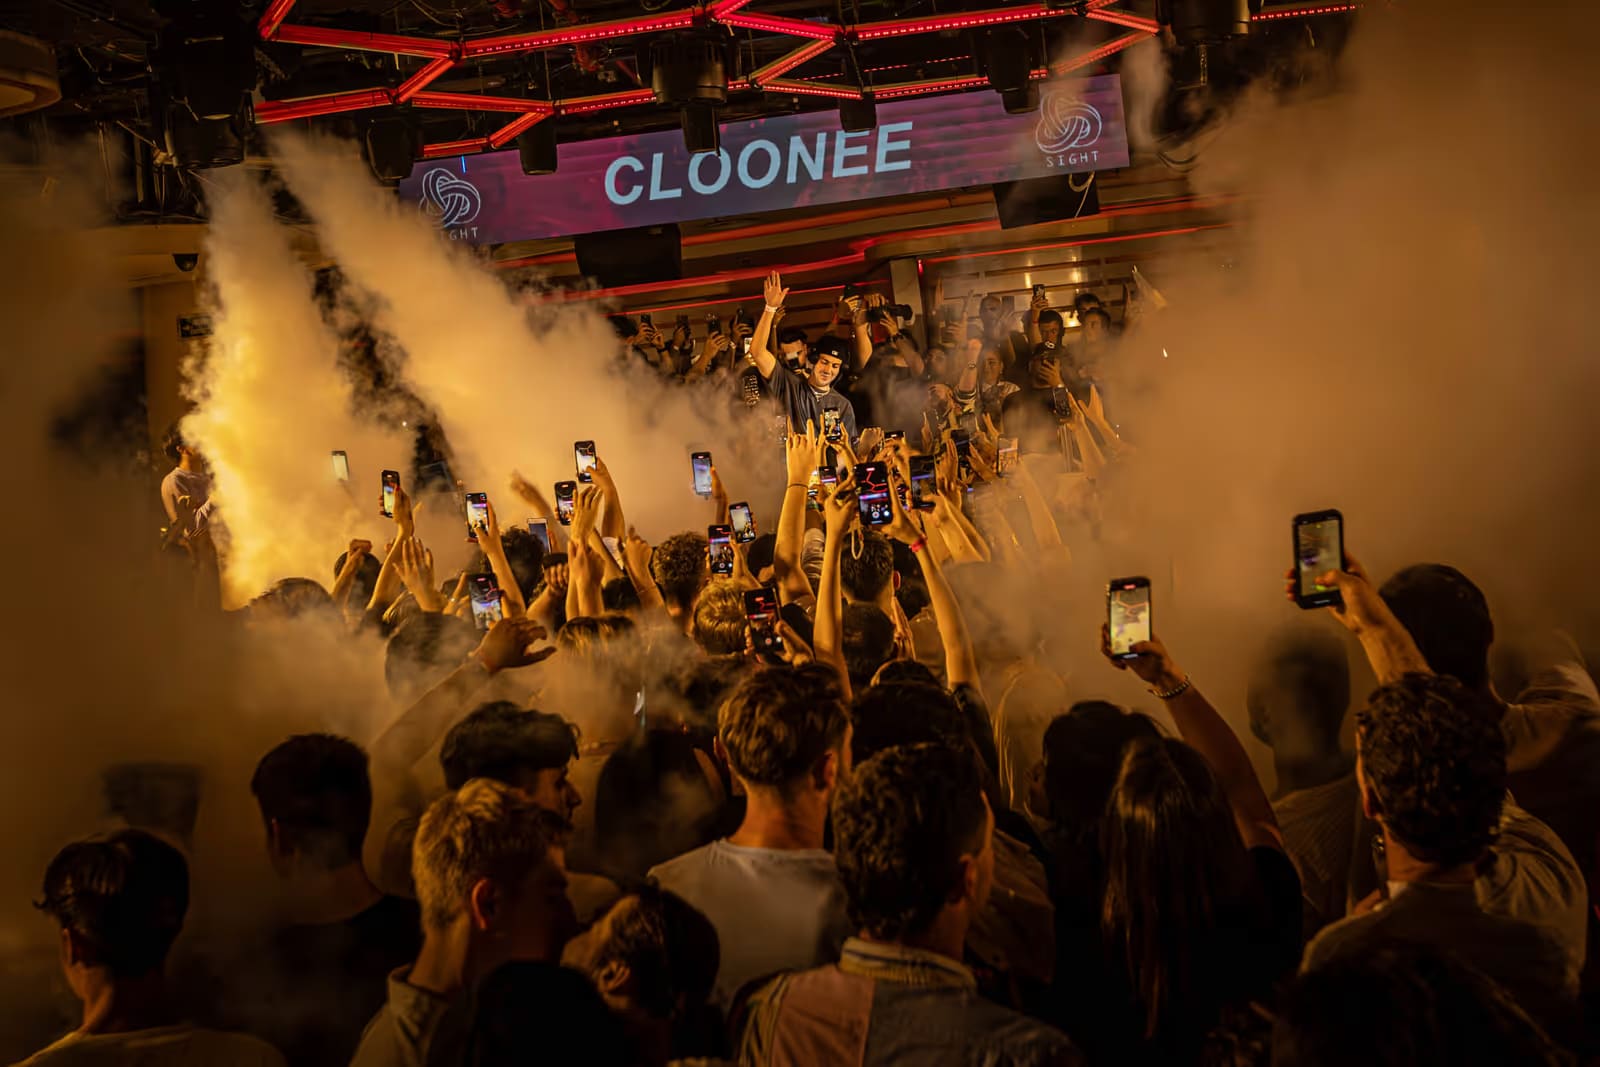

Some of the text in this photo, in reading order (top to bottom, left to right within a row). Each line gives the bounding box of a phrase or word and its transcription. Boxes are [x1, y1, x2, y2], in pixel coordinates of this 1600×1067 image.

[604, 121, 913, 205] CLOONEE
[1046, 151, 1099, 167] SIGHT
[438, 226, 479, 241] IGHT
